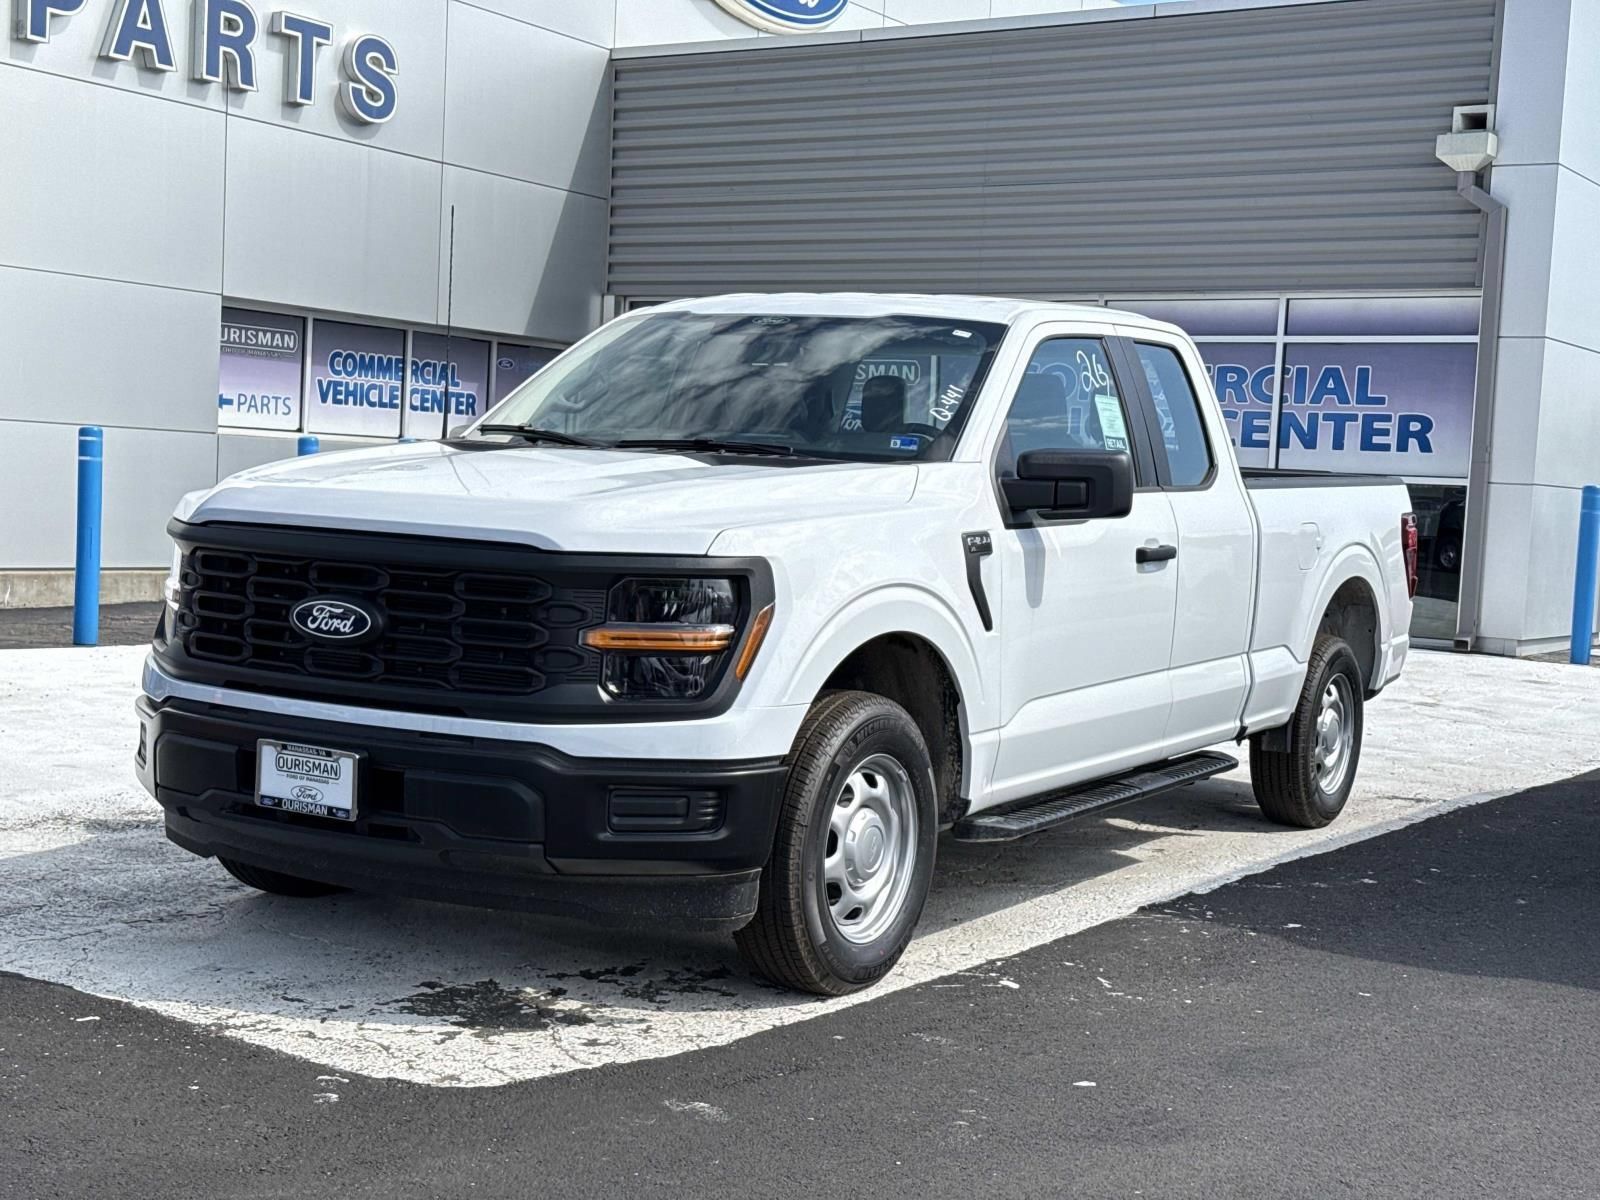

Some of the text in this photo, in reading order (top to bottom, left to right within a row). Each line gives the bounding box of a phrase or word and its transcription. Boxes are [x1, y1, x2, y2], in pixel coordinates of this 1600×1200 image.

[221, 327, 295, 348] URISMAN
[329, 350, 461, 387] COMMERCIAL
[317, 378, 400, 410] VEHICLE
[1206, 364, 1387, 407] RCIAL
[237, 393, 292, 416] PARTS
[307, 605, 356, 633] Ford
[277, 756, 338, 777] OURISMAN
[296, 787, 318, 800] Ford
[281, 799, 328, 816] OURISMAN
